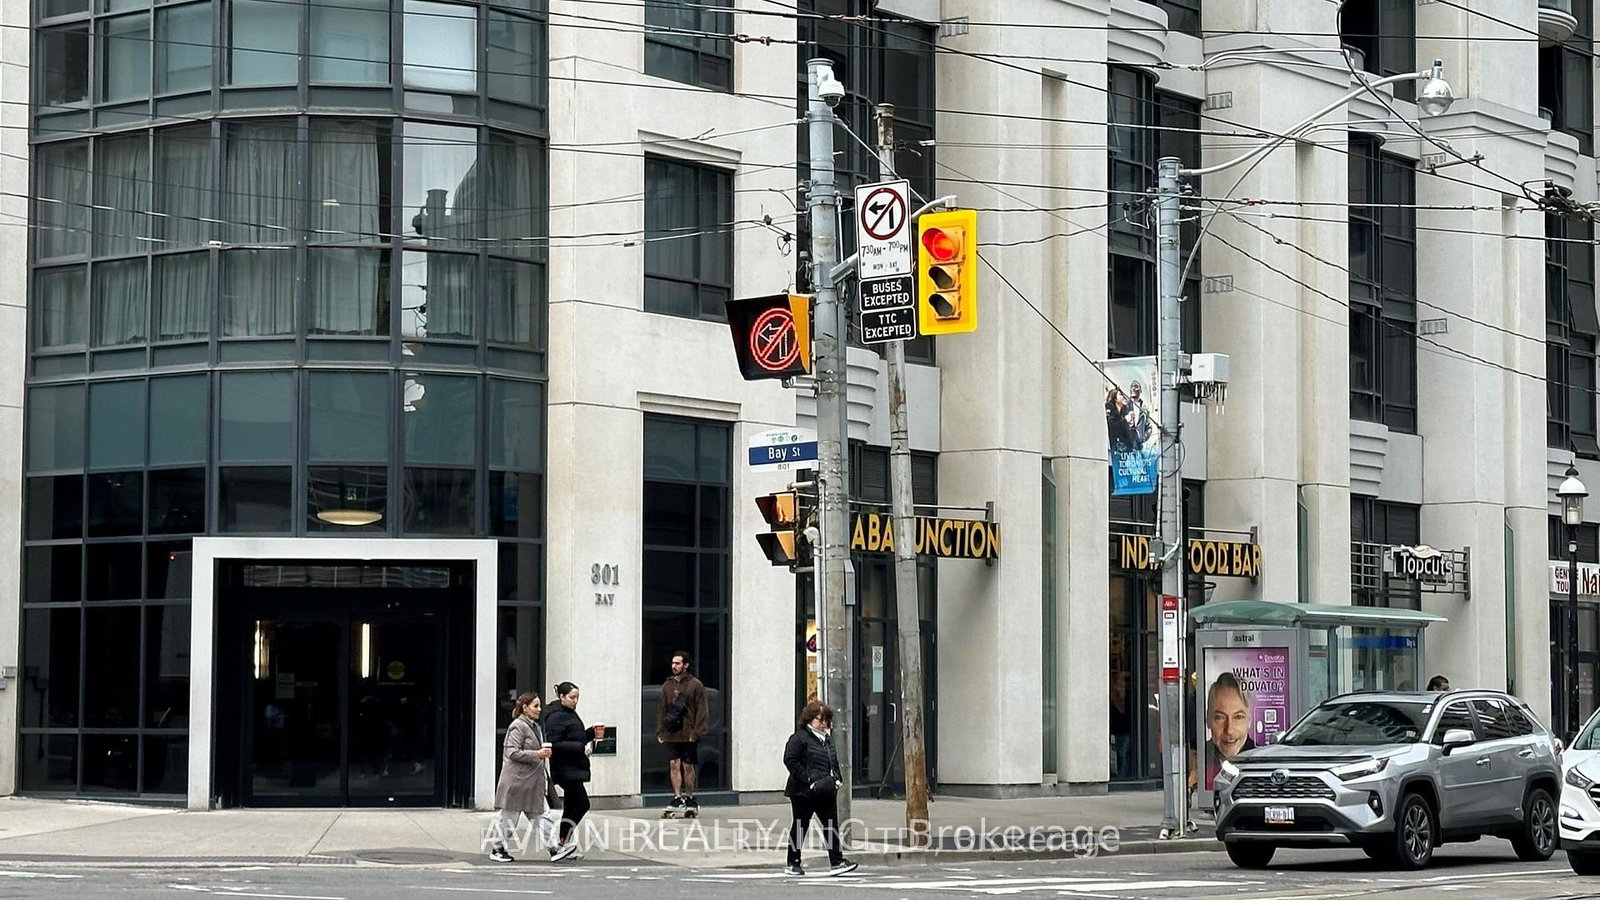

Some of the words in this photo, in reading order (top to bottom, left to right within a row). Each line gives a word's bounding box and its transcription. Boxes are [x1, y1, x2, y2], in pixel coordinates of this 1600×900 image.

[872, 281, 902, 295] BUSES
[864, 292, 910, 307] EXCEPTED
[878, 313, 897, 325] TTC
[865, 324, 912, 339] EXCEPTED
[768, 447, 787, 461] Bay
[792, 446, 801, 457] St
[1132, 474, 1150, 484] HEART
[851, 513, 895, 552] ABA
[914, 517, 1000, 558] UNCTION
[1188, 540, 1229, 574] OOD
[1232, 543, 1263, 576] BAR
[1400, 551, 1454, 580] Topcuts
[591, 563, 619, 586] 801
[594, 592, 615, 606] BAY
[1234, 634, 1255, 643] astral
[1233, 667, 1270, 678] WHAT'S
[1272, 667, 1285, 678] IN
[1240, 680, 1285, 692] DOVATO?
